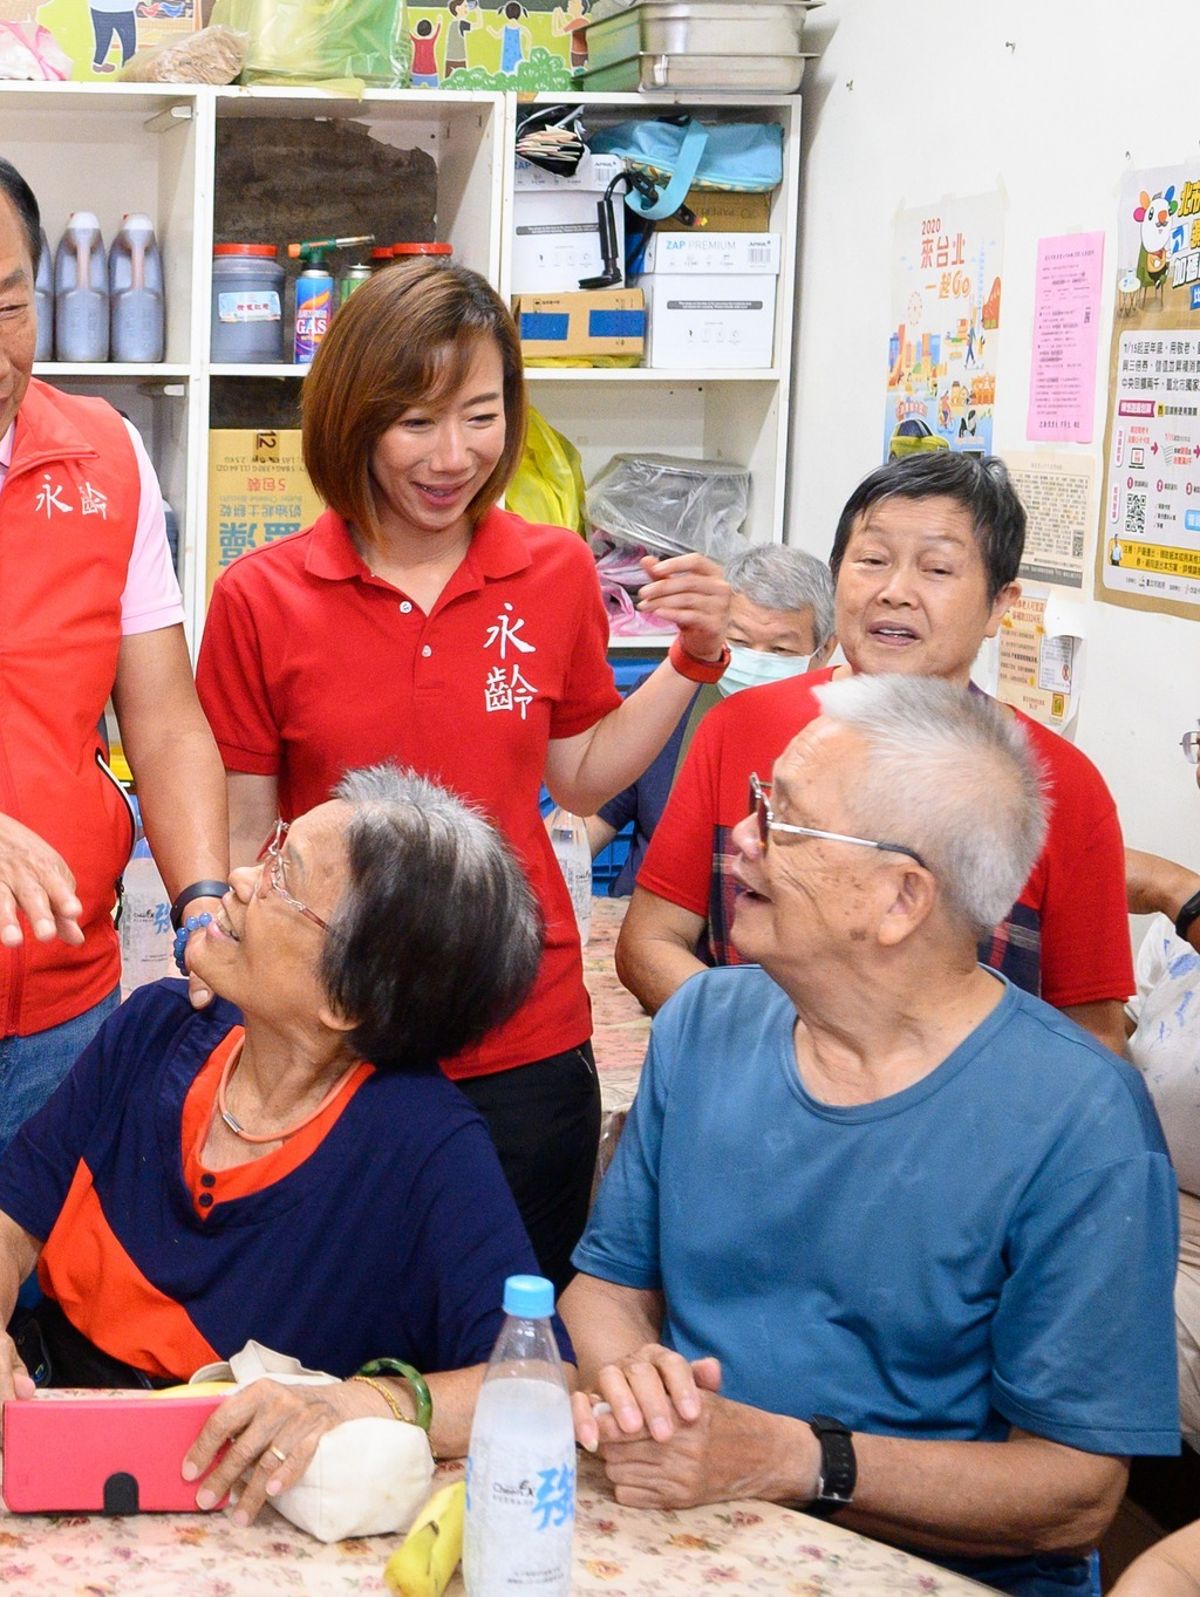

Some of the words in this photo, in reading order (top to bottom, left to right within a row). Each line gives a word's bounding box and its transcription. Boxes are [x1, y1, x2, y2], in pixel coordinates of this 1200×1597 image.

[921, 217, 941, 235] 2020
[666, 240, 686, 250] ZAP
[687, 240, 736, 250] PREMIUM
[920, 233, 965, 269] 來台北
[296, 320, 327, 335] GAS
[35, 473, 108, 520] 永齡
[482, 602, 539, 720] 永齡
